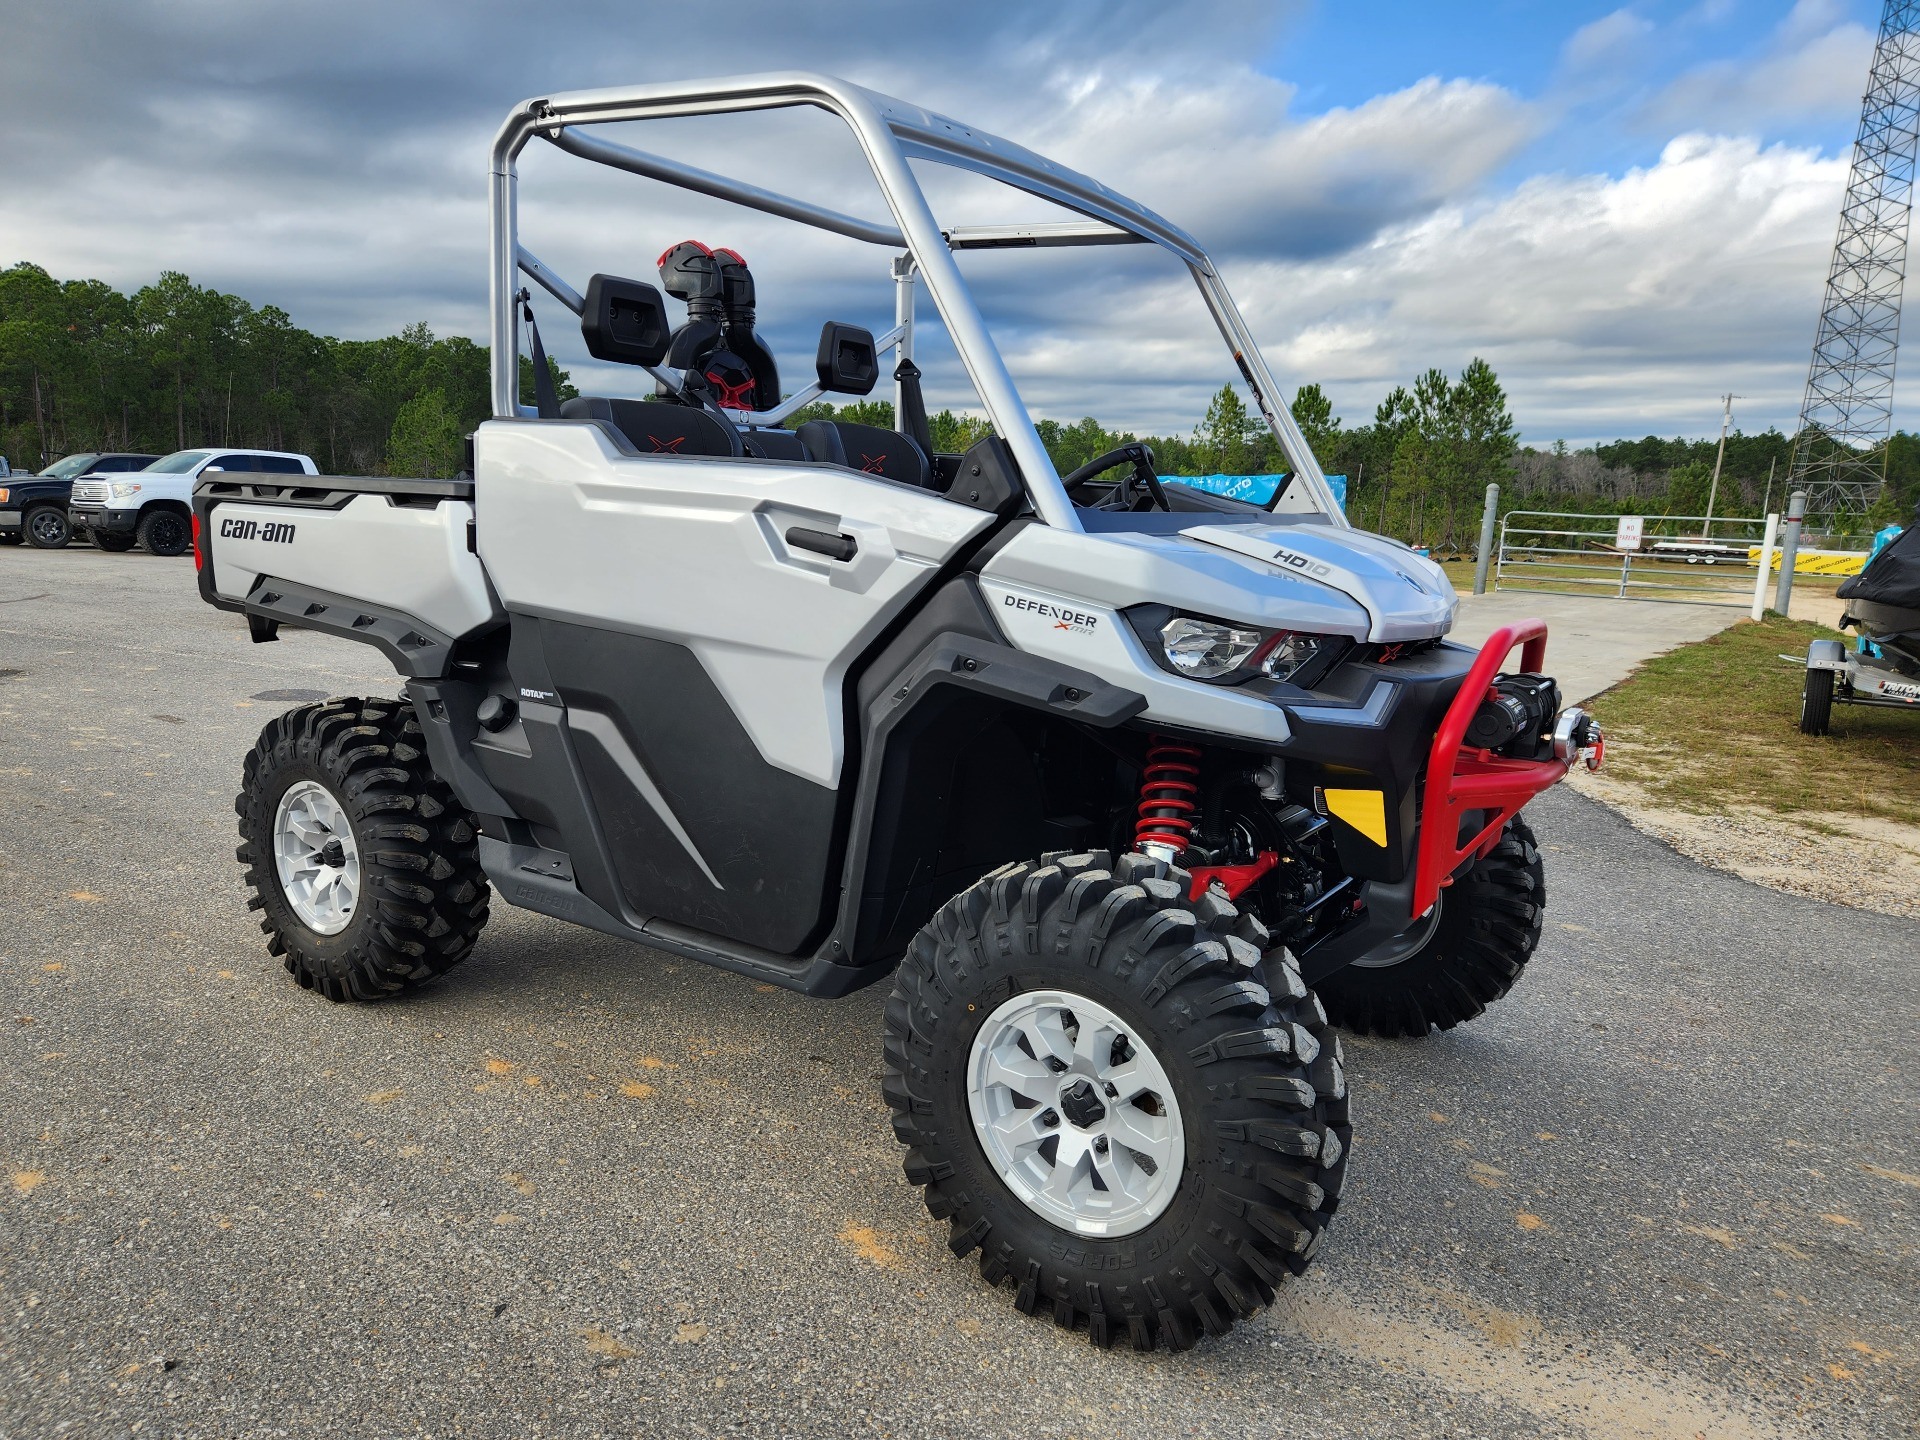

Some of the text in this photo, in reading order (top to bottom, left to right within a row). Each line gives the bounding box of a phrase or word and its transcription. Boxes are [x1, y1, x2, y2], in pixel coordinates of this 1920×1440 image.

[221, 518, 296, 544] can-am
[1273, 549, 1332, 577] HD10
[1004, 594, 1097, 628] DEFENDER
[521, 687, 545, 699] ROTAX
